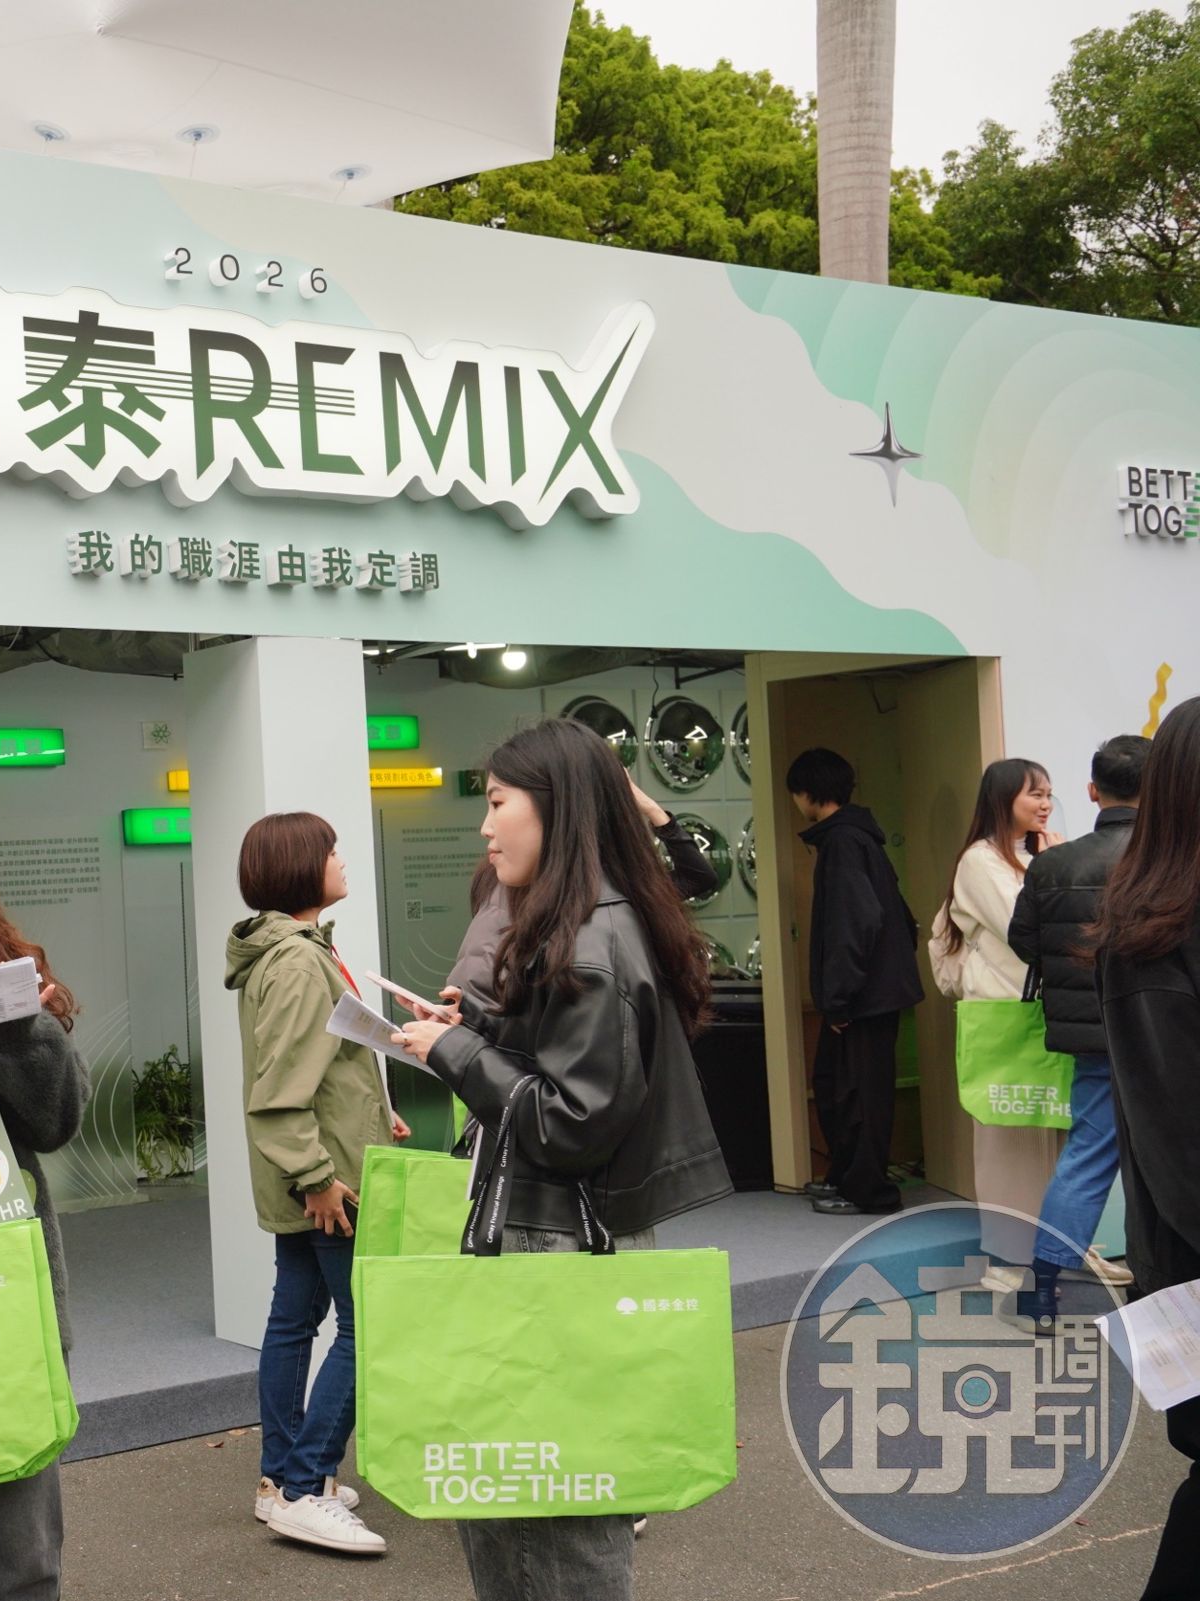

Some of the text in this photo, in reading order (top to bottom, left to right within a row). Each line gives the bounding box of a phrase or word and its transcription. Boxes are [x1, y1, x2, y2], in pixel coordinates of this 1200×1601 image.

[174, 247, 328, 294] 2026
[77, 530, 440, 590] 我的職涯由我定調
[988, 1084, 1058, 1100] BETTER
[487, 1176, 505, 1243] Cathay Financial Holdings
[424, 1442, 561, 1472] BETTER
[423, 1473, 617, 1504] TOGETHER
